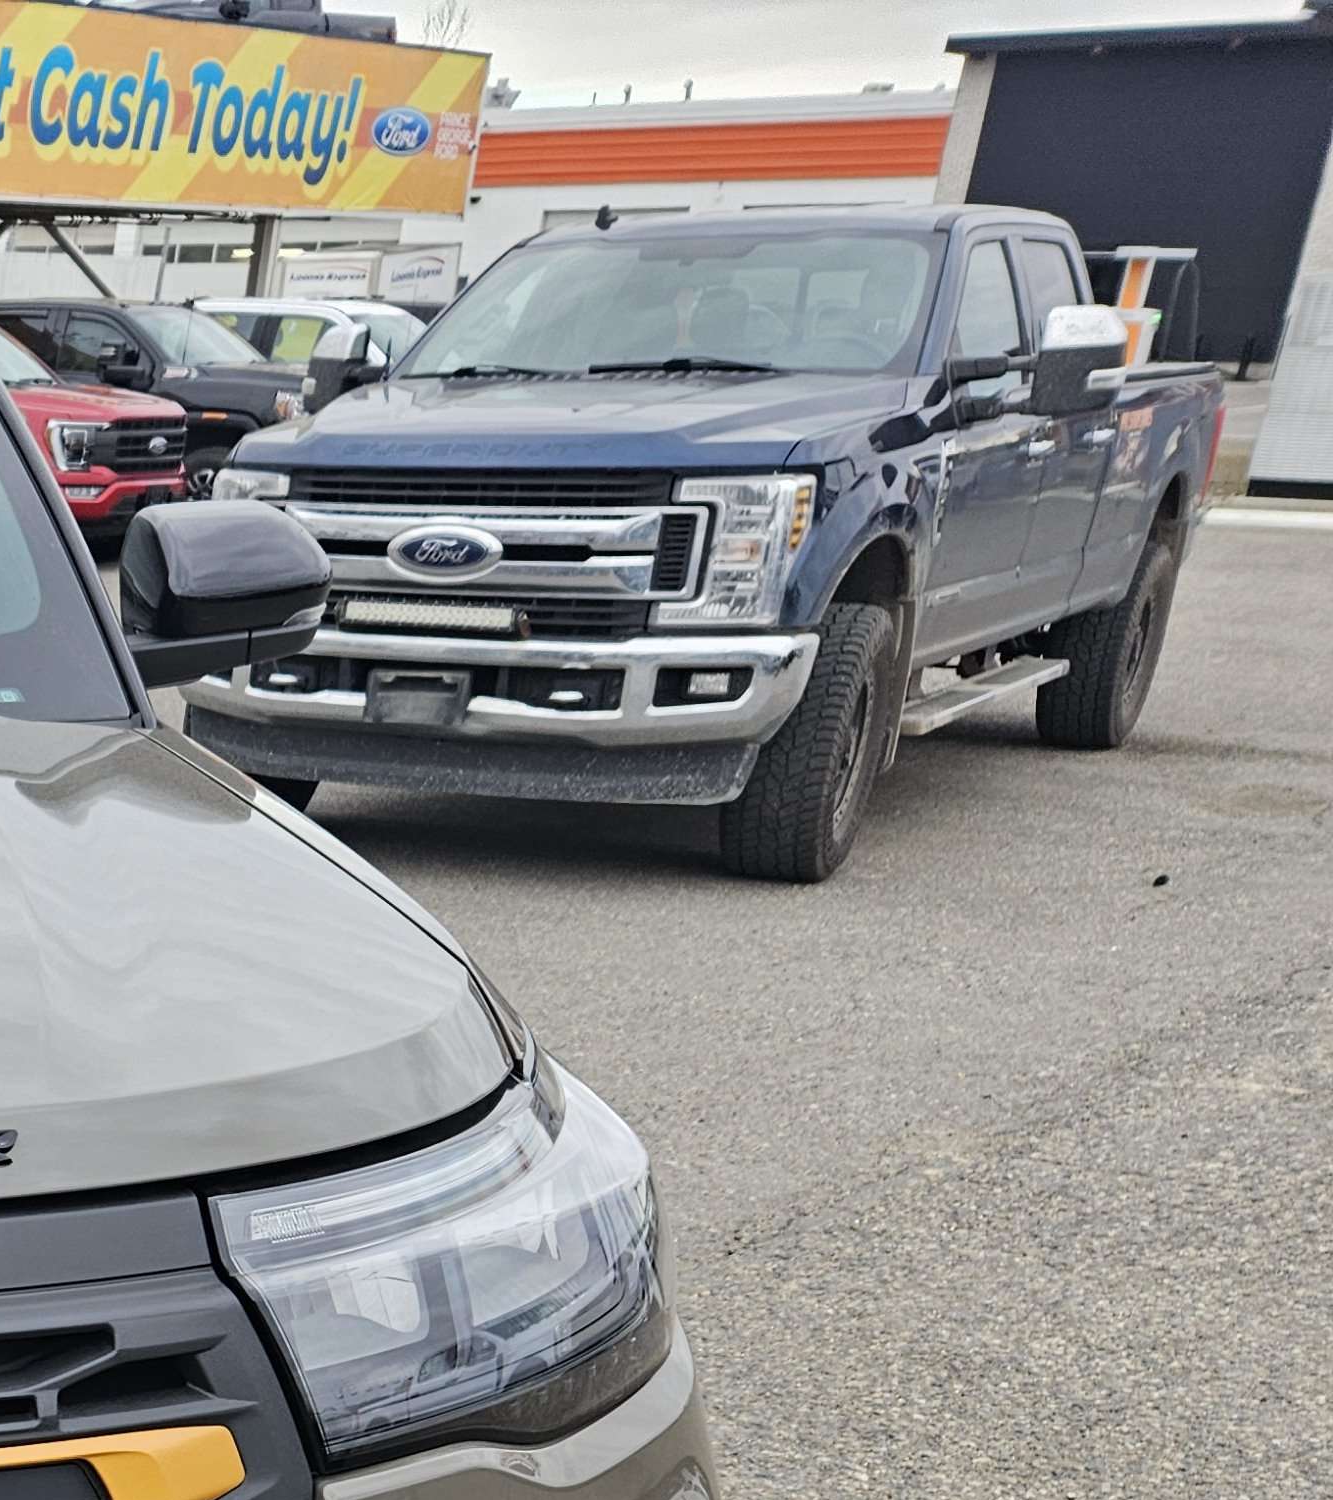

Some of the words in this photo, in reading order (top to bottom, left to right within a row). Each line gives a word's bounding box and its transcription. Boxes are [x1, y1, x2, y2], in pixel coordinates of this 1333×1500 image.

[31, 44, 170, 152] Cash
[189, 62, 363, 186] Today!
[381, 113, 421, 147] Ford
[415, 539, 469, 563] Ford
